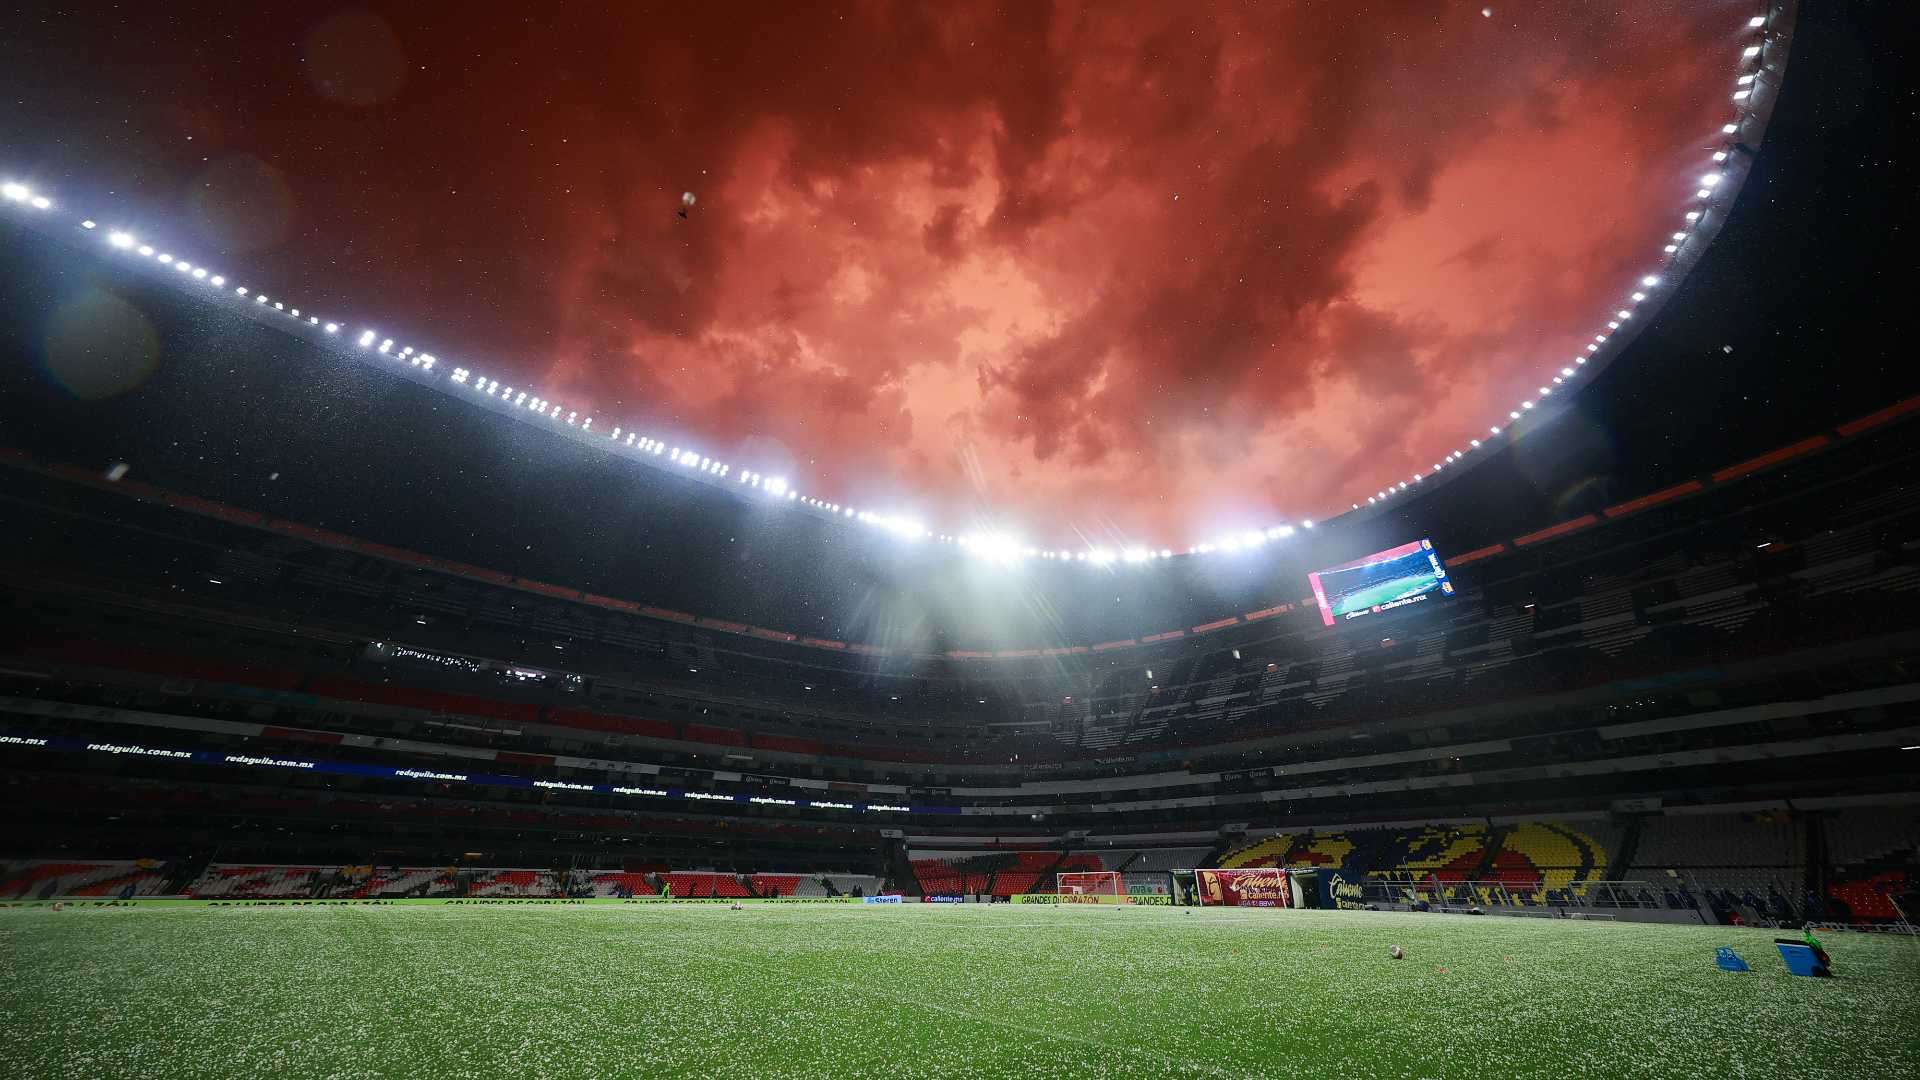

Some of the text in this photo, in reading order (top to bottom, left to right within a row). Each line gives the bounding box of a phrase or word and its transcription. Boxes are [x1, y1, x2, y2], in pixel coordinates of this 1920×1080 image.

[1380, 593, 1428, 611] caliente.mx
[87, 743, 193, 759] redaguila.com.mx
[225, 755, 315, 769] redaguila.com.mx
[395, 769, 468, 782] redaguila.com.mx
[533, 780, 594, 792] redaguila.com.mx
[612, 786, 668, 797] redaguila.com.mx
[1021, 895, 1051, 905] GRANDES
[1126, 896, 1164, 906] GRANDES
